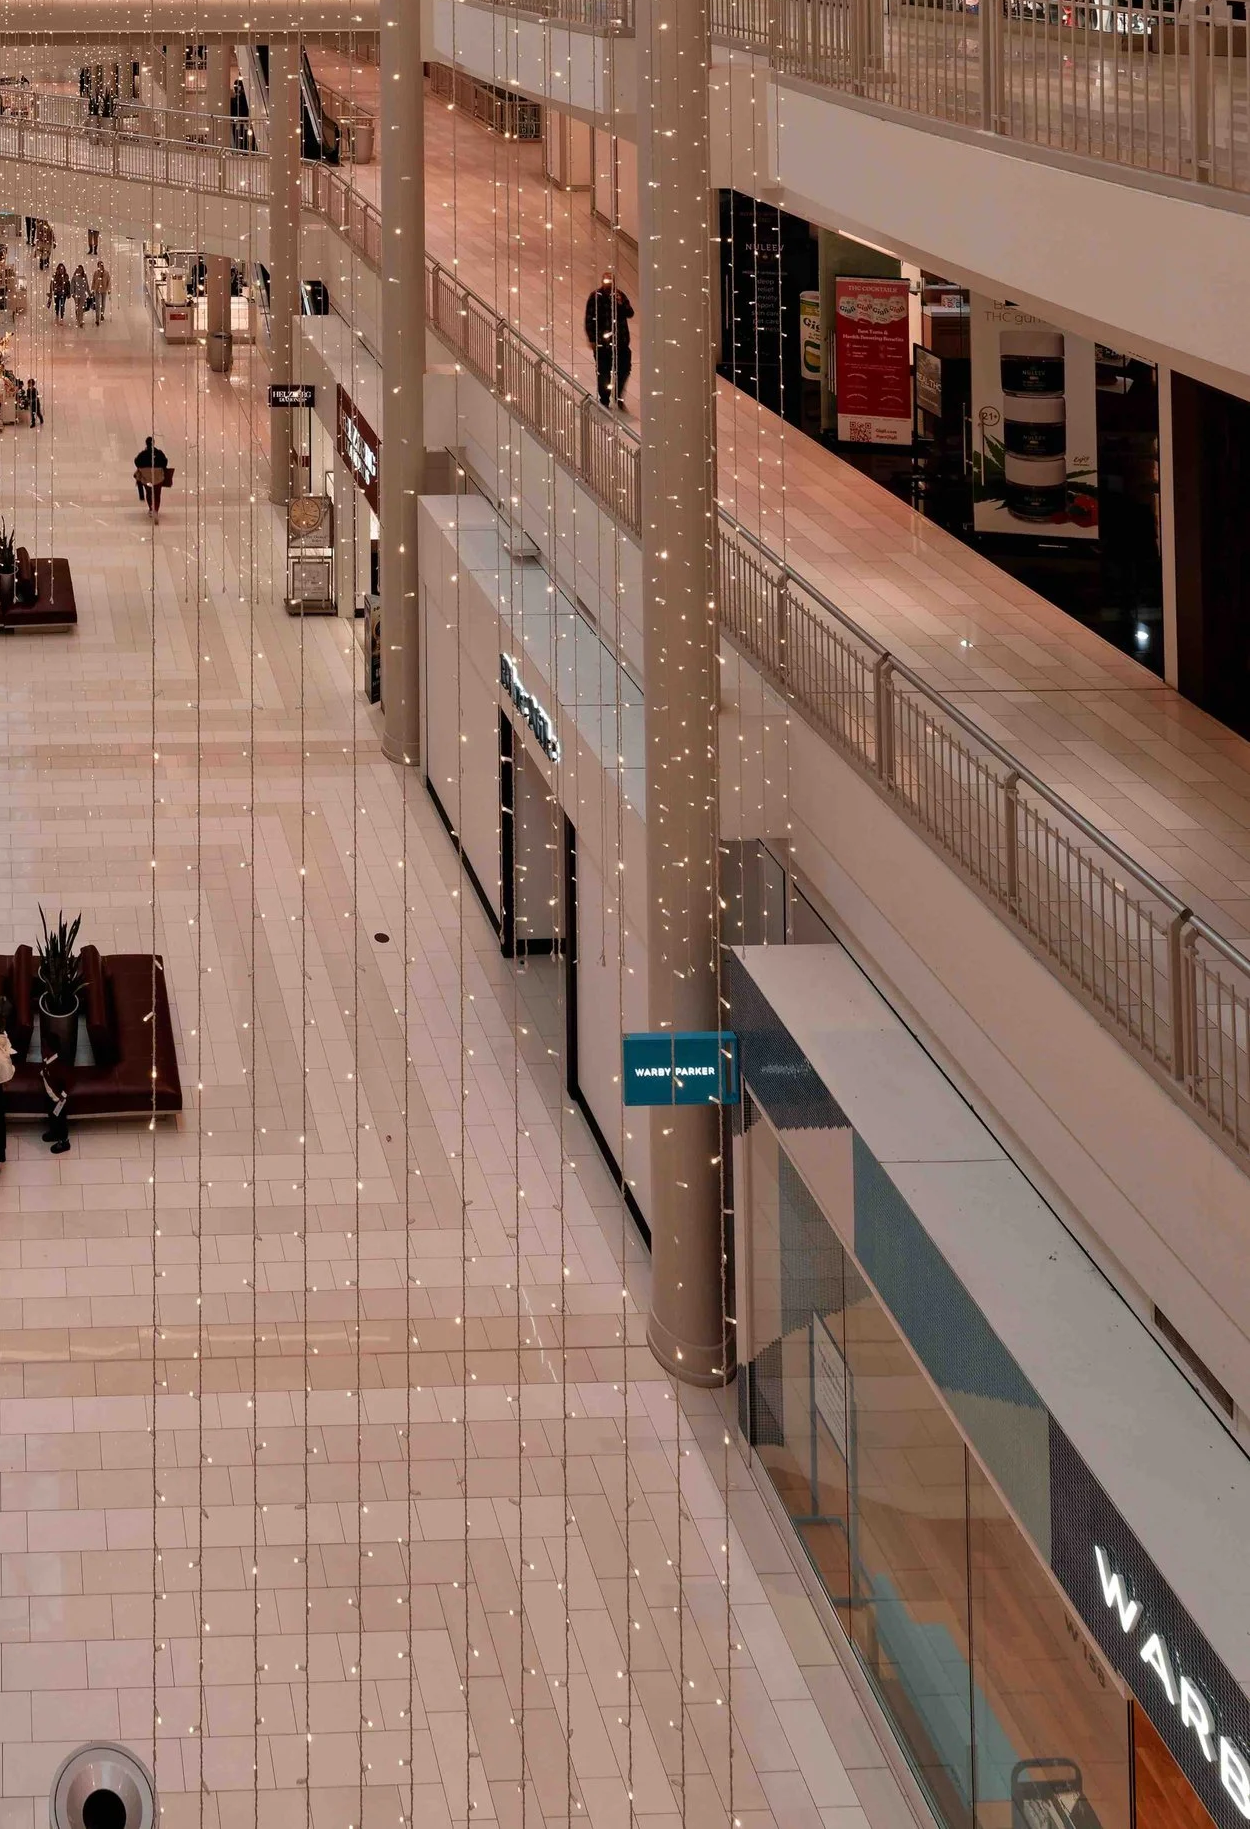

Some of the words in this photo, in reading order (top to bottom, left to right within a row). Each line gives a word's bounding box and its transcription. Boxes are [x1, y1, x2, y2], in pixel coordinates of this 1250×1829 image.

[984, 311, 1012, 322] THC
[982, 412, 998, 420] 21+
[635, 1067, 671, 1077] WARBY
[675, 1066, 716, 1076] PARKER
